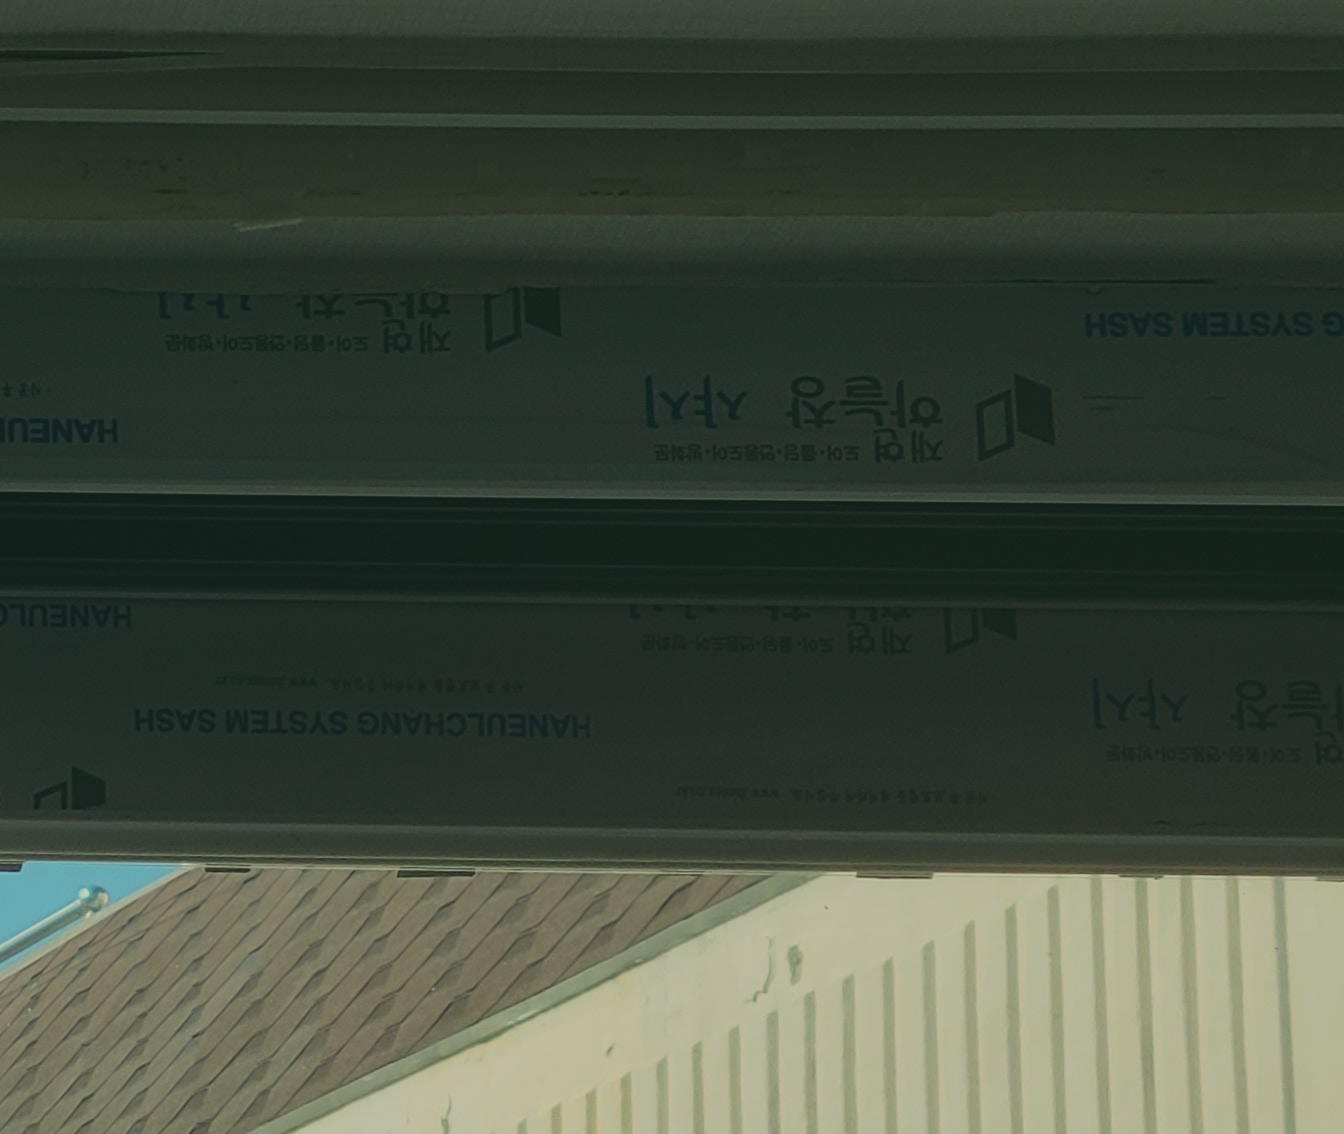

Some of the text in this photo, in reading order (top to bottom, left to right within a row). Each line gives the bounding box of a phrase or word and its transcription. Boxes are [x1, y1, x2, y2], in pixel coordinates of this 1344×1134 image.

[382, 318, 452, 353] 재현
[1084, 311, 1174, 338] SASH
[1182, 310, 1314, 337] SYSTEM
[644, 374, 944, 428] 하늘창 샤시
[873, 428, 944, 464] 재현
[848, 622, 914, 655] 재현
[1092, 677, 1190, 730] 샤시
[133, 706, 591, 738] HANEULCHANG SYSTEM SASH
